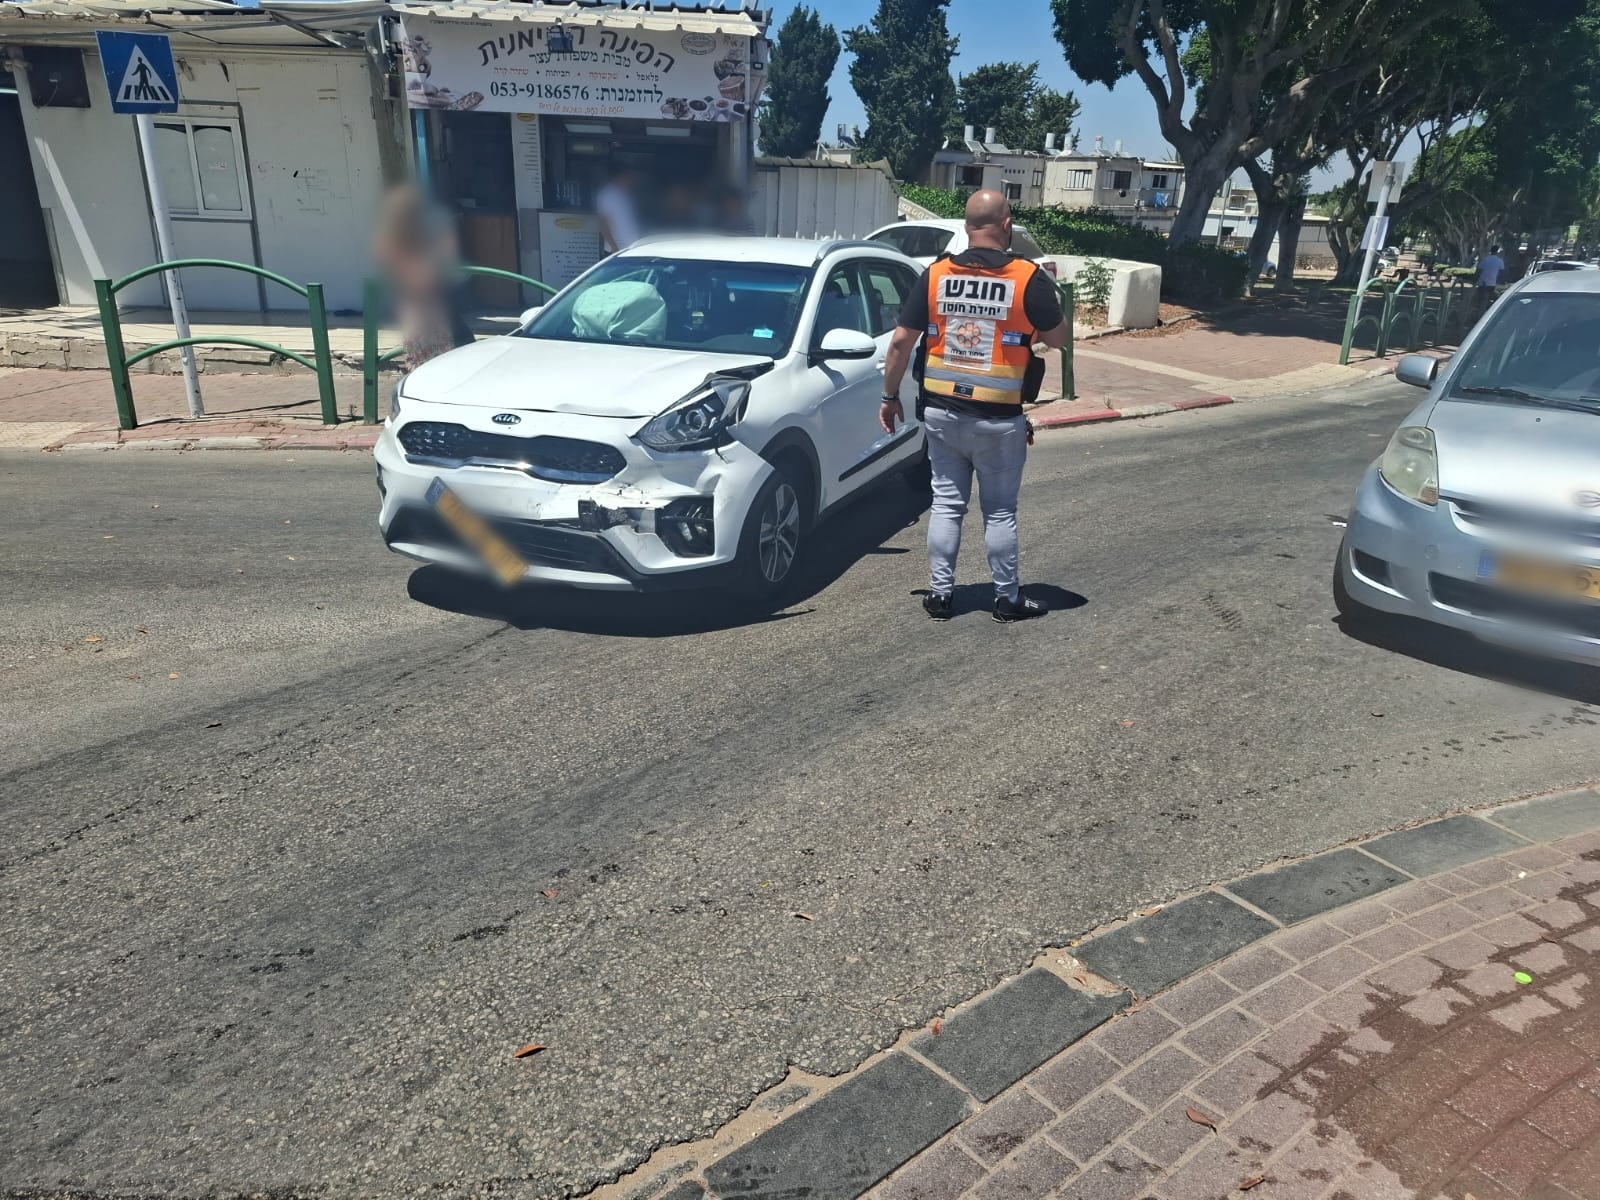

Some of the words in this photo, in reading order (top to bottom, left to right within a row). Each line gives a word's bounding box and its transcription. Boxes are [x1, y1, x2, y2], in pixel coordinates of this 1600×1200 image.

[478, 25, 585, 67] הימנית
[600, 30, 675, 74] הפינה
[557, 50, 598, 63] משפחת
[602, 52, 632, 68] מבית
[636, 72, 660, 81] פלאפל
[490, 81, 589, 101] 053-9186576
[596, 83, 664, 103] להזמנות:
[945, 279, 1006, 301] חובש
[943, 302, 966, 313] חוסן
[969, 304, 1001, 316] יחידת
